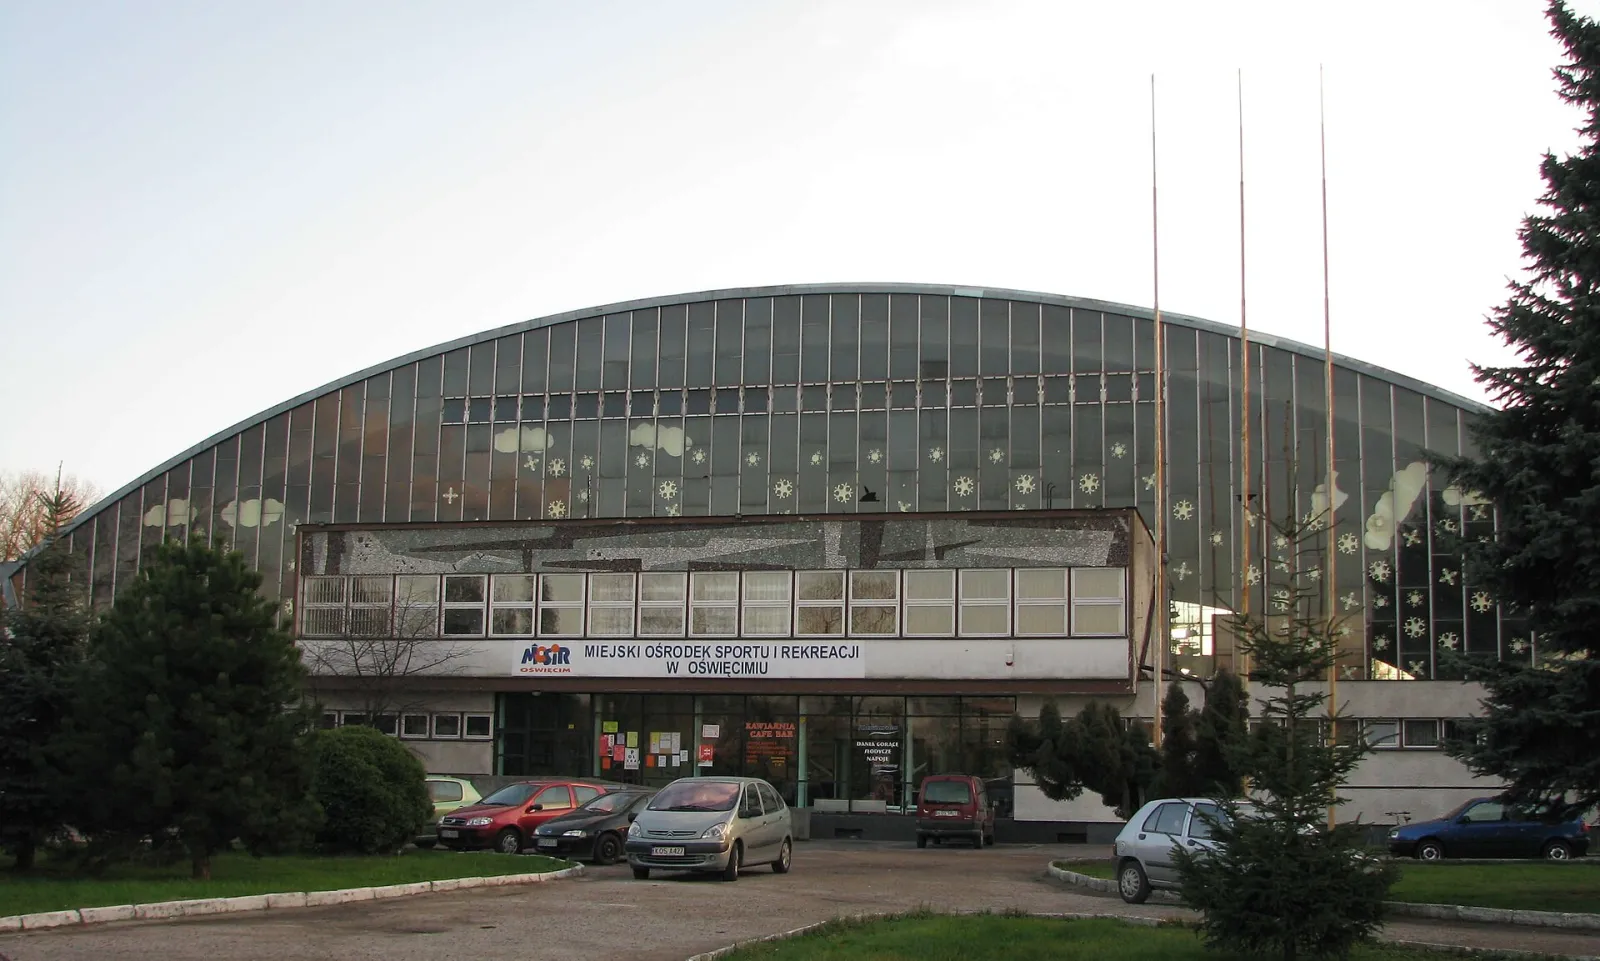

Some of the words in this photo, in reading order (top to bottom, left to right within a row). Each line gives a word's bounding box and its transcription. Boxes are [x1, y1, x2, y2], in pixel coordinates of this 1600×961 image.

[584, 645, 640, 658] MIEJSKI
[645, 642, 711, 658] OŚRODEK
[715, 645, 770, 658] SPORTU
[774, 645, 777, 658] I
[781, 645, 859, 659] REKREACJI
[666, 661, 679, 674] W
[688, 659, 768, 677] OŚWIĘCIMIU
[750, 730, 773, 738] CAFE
[775, 730, 794, 738] BAR
